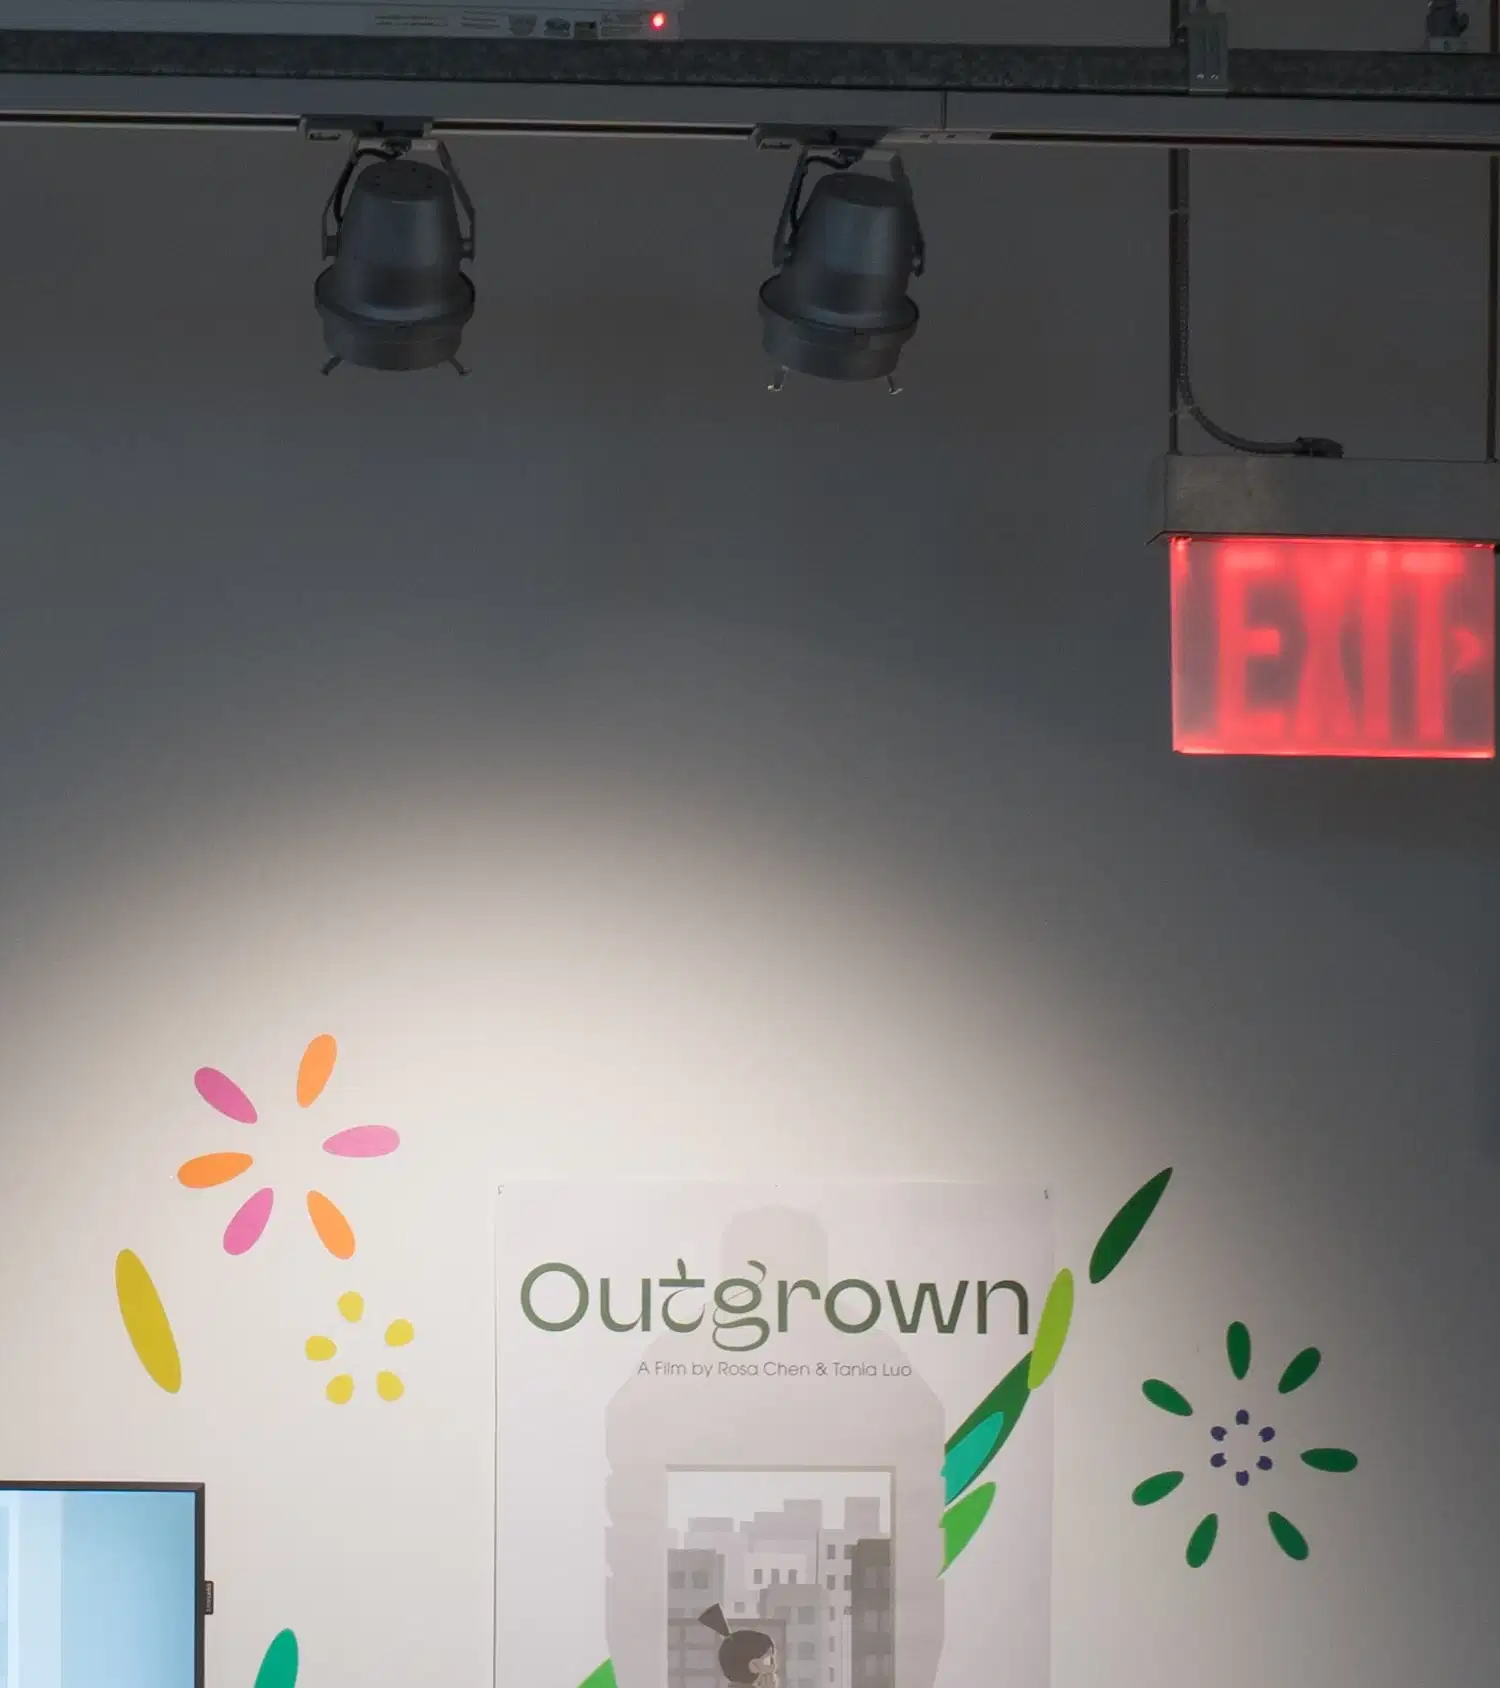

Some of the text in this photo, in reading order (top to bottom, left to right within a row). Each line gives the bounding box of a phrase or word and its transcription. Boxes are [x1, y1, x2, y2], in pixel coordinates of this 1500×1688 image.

[1218, 548, 1464, 743] EXIT
[520, 1258, 1029, 1352] Outgrown
[637, 1361, 913, 1379] A Film by Rosa Chen & Tania Luo
